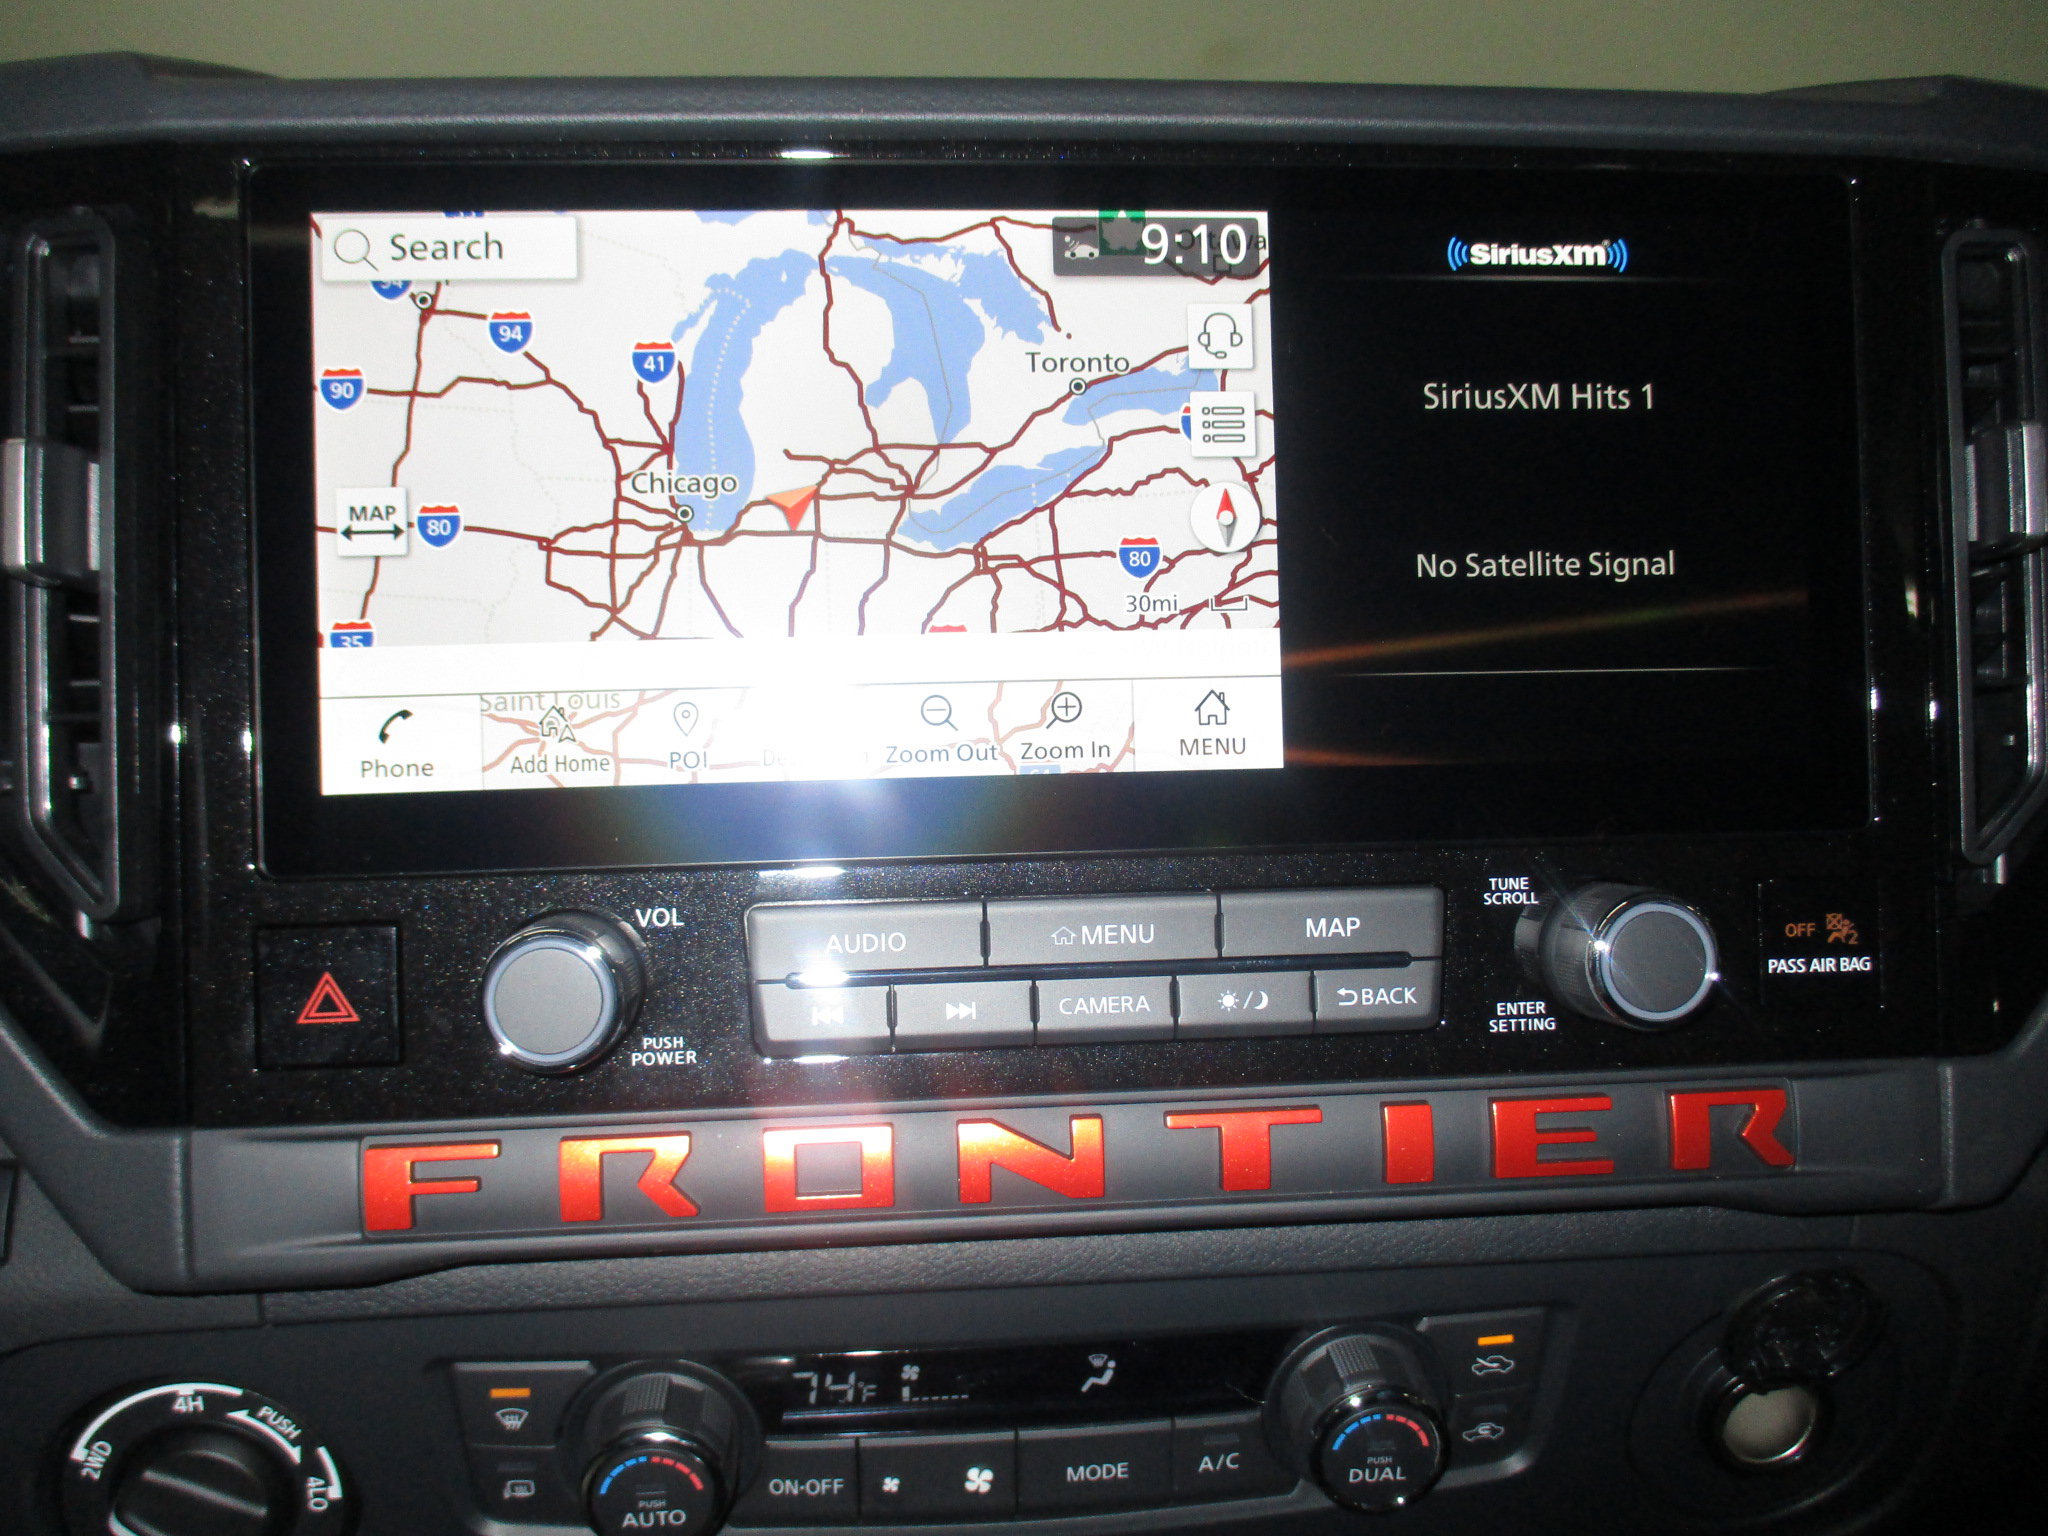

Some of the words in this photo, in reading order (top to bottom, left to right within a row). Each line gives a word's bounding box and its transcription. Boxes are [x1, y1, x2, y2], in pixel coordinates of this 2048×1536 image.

[390, 231, 503, 262] Search
[1141, 223, 1248, 265] 9:10
[498, 330, 523, 343] 94
[642, 354, 666, 373] 41
[1025, 351, 1130, 374] Toronto
[329, 380, 355, 400] 90
[1423, 381, 1561, 411] SiriusXM
[1571, 382, 1632, 410] Hits
[1641, 382, 1657, 410] 1
[631, 472, 738, 498] Chicago
[349, 505, 397, 522] MAP
[427, 519, 451, 537] 80
[1129, 551, 1151, 567] 80
[1416, 553, 1457, 578] No
[1465, 550, 1581, 578] Satellite
[1588, 550, 1675, 583] Signal
[1126, 594, 1178, 613] 30mi
[885, 743, 949, 763] Zoom
[957, 741, 998, 763] Out
[1020, 741, 1083, 761] Zoom
[1091, 740, 1111, 759] In
[1179, 737, 1246, 757] MENU
[360, 759, 434, 778] Phone
[510, 756, 548, 774] Add
[554, 753, 610, 773] Home
[669, 750, 707, 769] POI
[1488, 877, 1529, 891] TUNE
[1483, 891, 1539, 906] SCROLL
[635, 907, 685, 928] VOL
[1306, 917, 1361, 937] MAP
[1081, 924, 1154, 945] MENU
[1785, 922, 1816, 937] OFF
[826, 932, 907, 953] AUDIO
[1768, 957, 1806, 974] PASS
[1809, 957, 1837, 973] AIR
[1839, 956, 1872, 972] BAG
[1059, 996, 1150, 1015] CAMERA
[1361, 987, 1417, 1005] BACK
[1496, 1001, 1546, 1017] ENTER
[1489, 1017, 1556, 1033] SETTING
[643, 1036, 685, 1050] PUSH
[631, 1050, 698, 1067] POWER
[365, 1088, 1796, 1232] FRONTIER
[173, 1396, 204, 1414] 4H
[256, 1405, 301, 1440] PUSH
[80, 1440, 112, 1481] 2WD
[1198, 1452, 1240, 1473] A/C
[1366, 1455, 1393, 1465] PUSH
[1066, 1462, 1130, 1482] MODE
[1349, 1466, 1406, 1483] DUAL
[306, 1476, 329, 1512] 4LO
[637, 1498, 667, 1509] PUSH
[622, 1508, 687, 1528] AUTO
